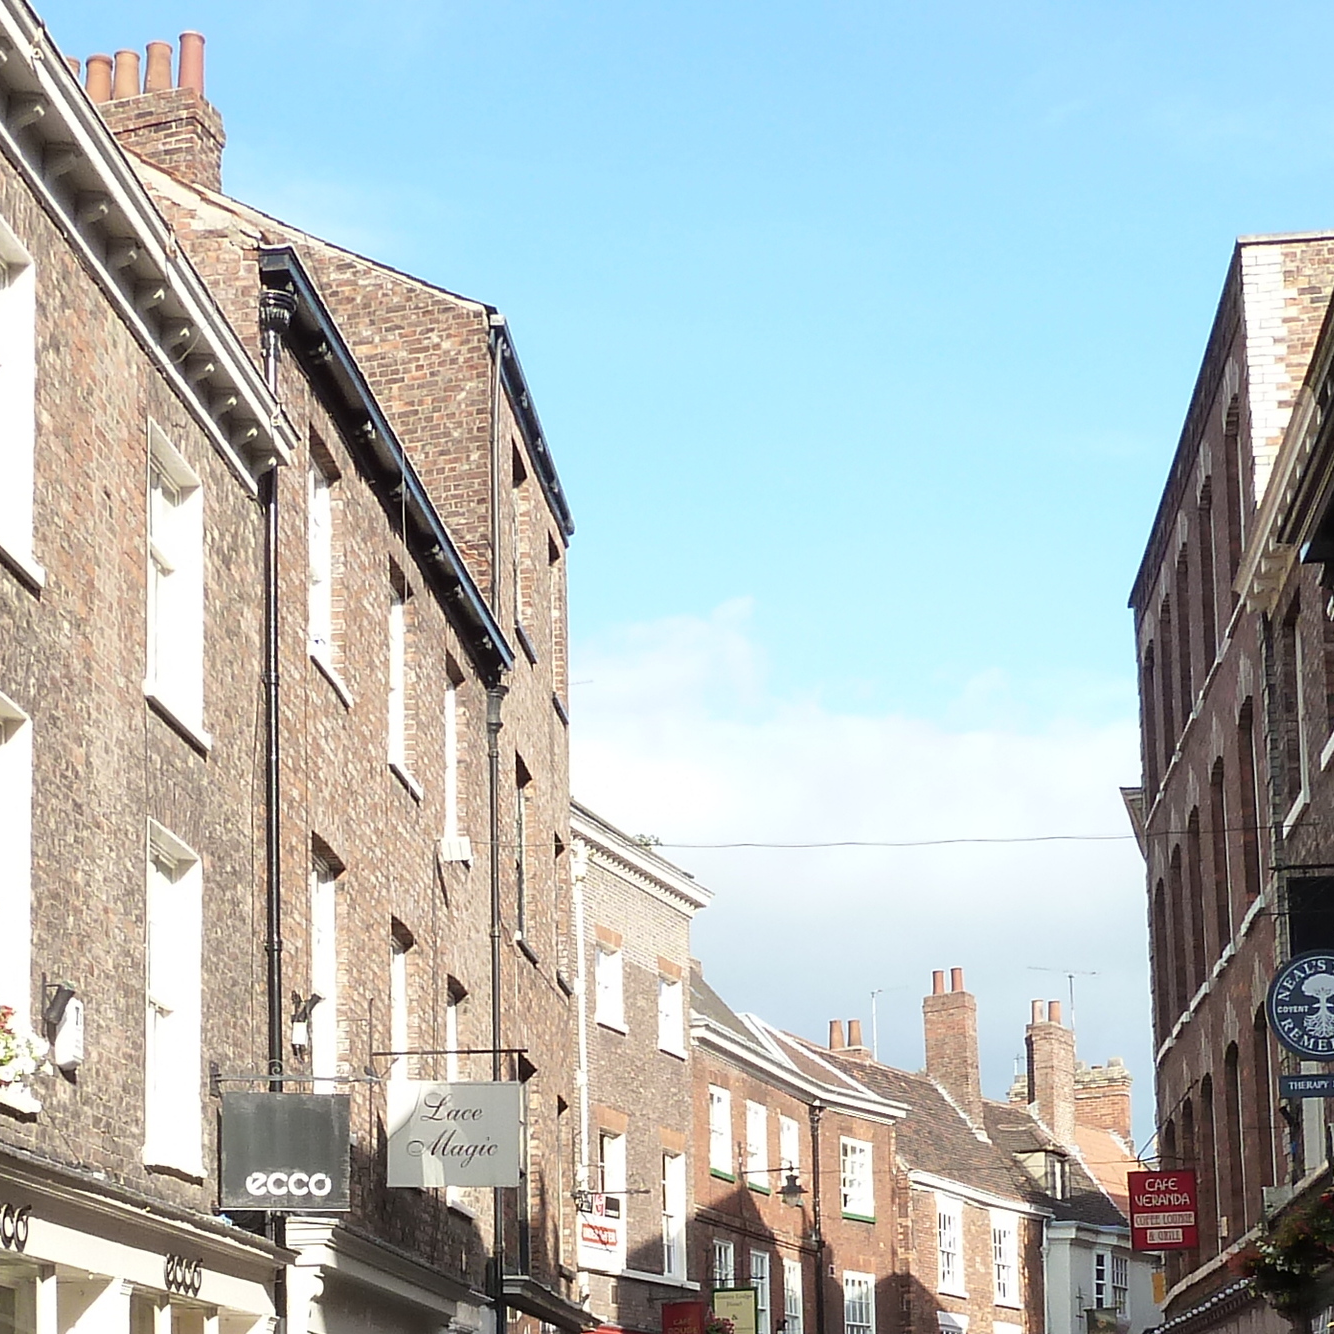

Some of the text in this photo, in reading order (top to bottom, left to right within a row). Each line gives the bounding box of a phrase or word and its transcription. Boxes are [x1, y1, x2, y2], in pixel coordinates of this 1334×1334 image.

[1277, 958, 1327, 1001] NEAL'S
[1288, 1080, 1329, 1090] THERAPY
[420, 1092, 484, 1122] Lace
[406, 1129, 499, 1169] Magic
[245, 1171, 332, 1197] ecco
[1145, 1178, 1179, 1192] CAFE
[1134, 1192, 1191, 1207] VERANDA
[163, 1253, 204, 1298] ecco
